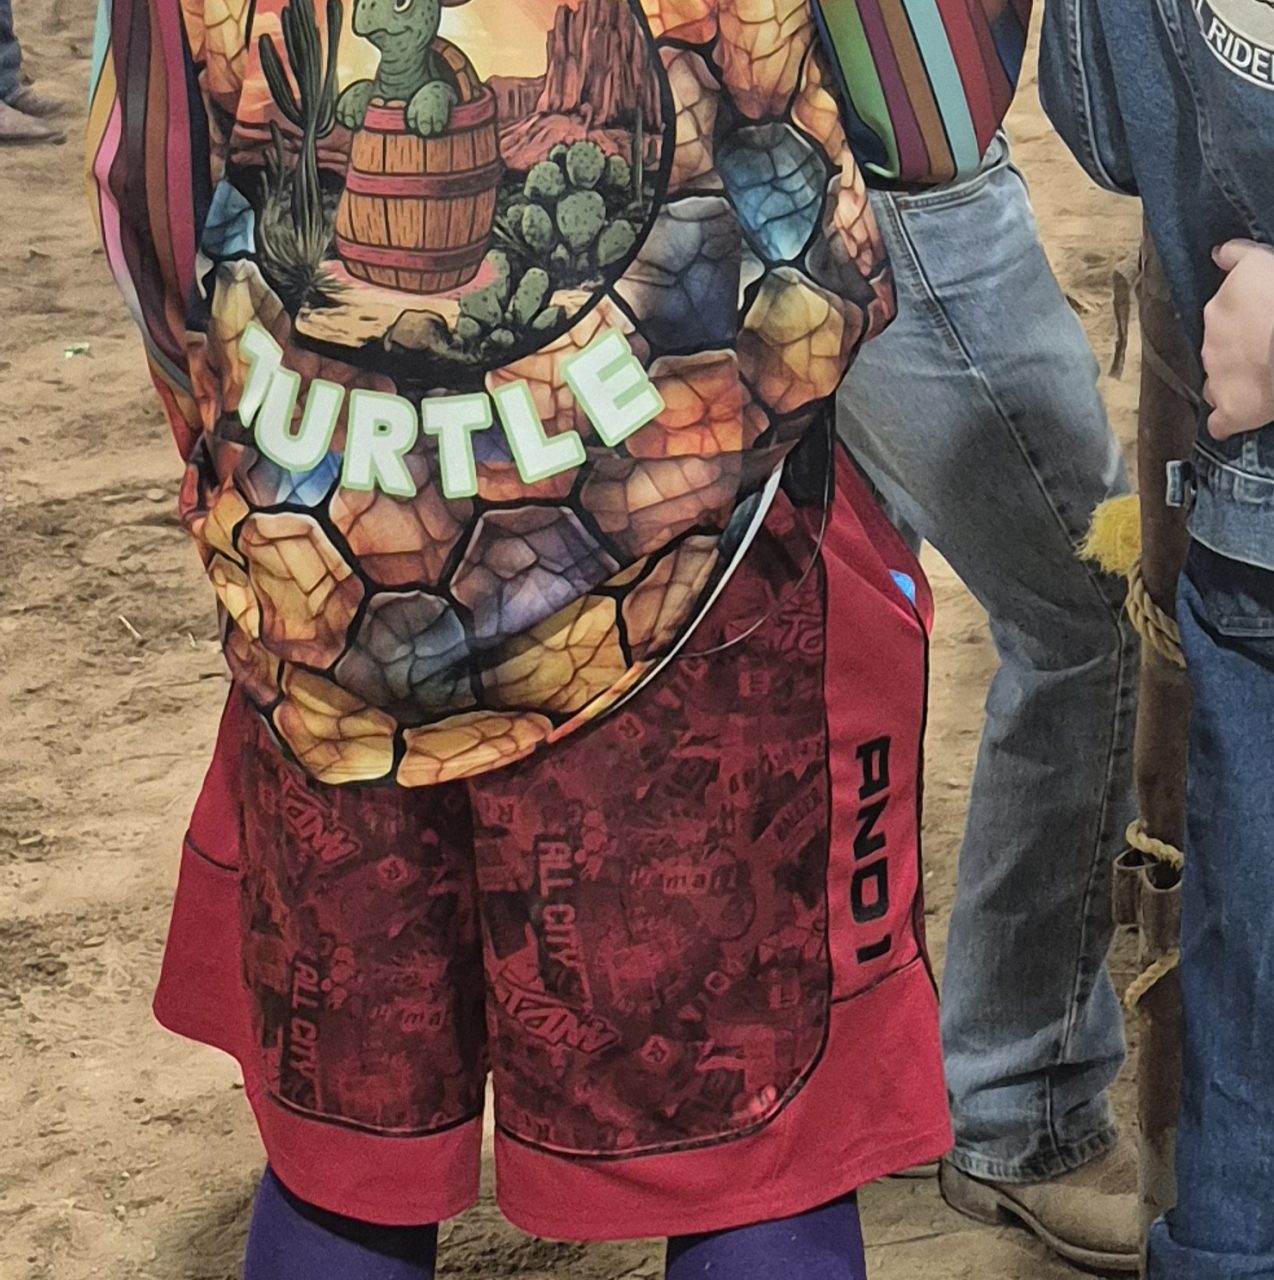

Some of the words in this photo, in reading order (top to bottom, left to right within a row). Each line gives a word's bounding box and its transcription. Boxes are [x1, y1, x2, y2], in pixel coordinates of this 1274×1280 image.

[237, 320, 666, 500] TURTLE
[539, 841, 574, 897] ALL
[542, 903, 579, 967] CITY
